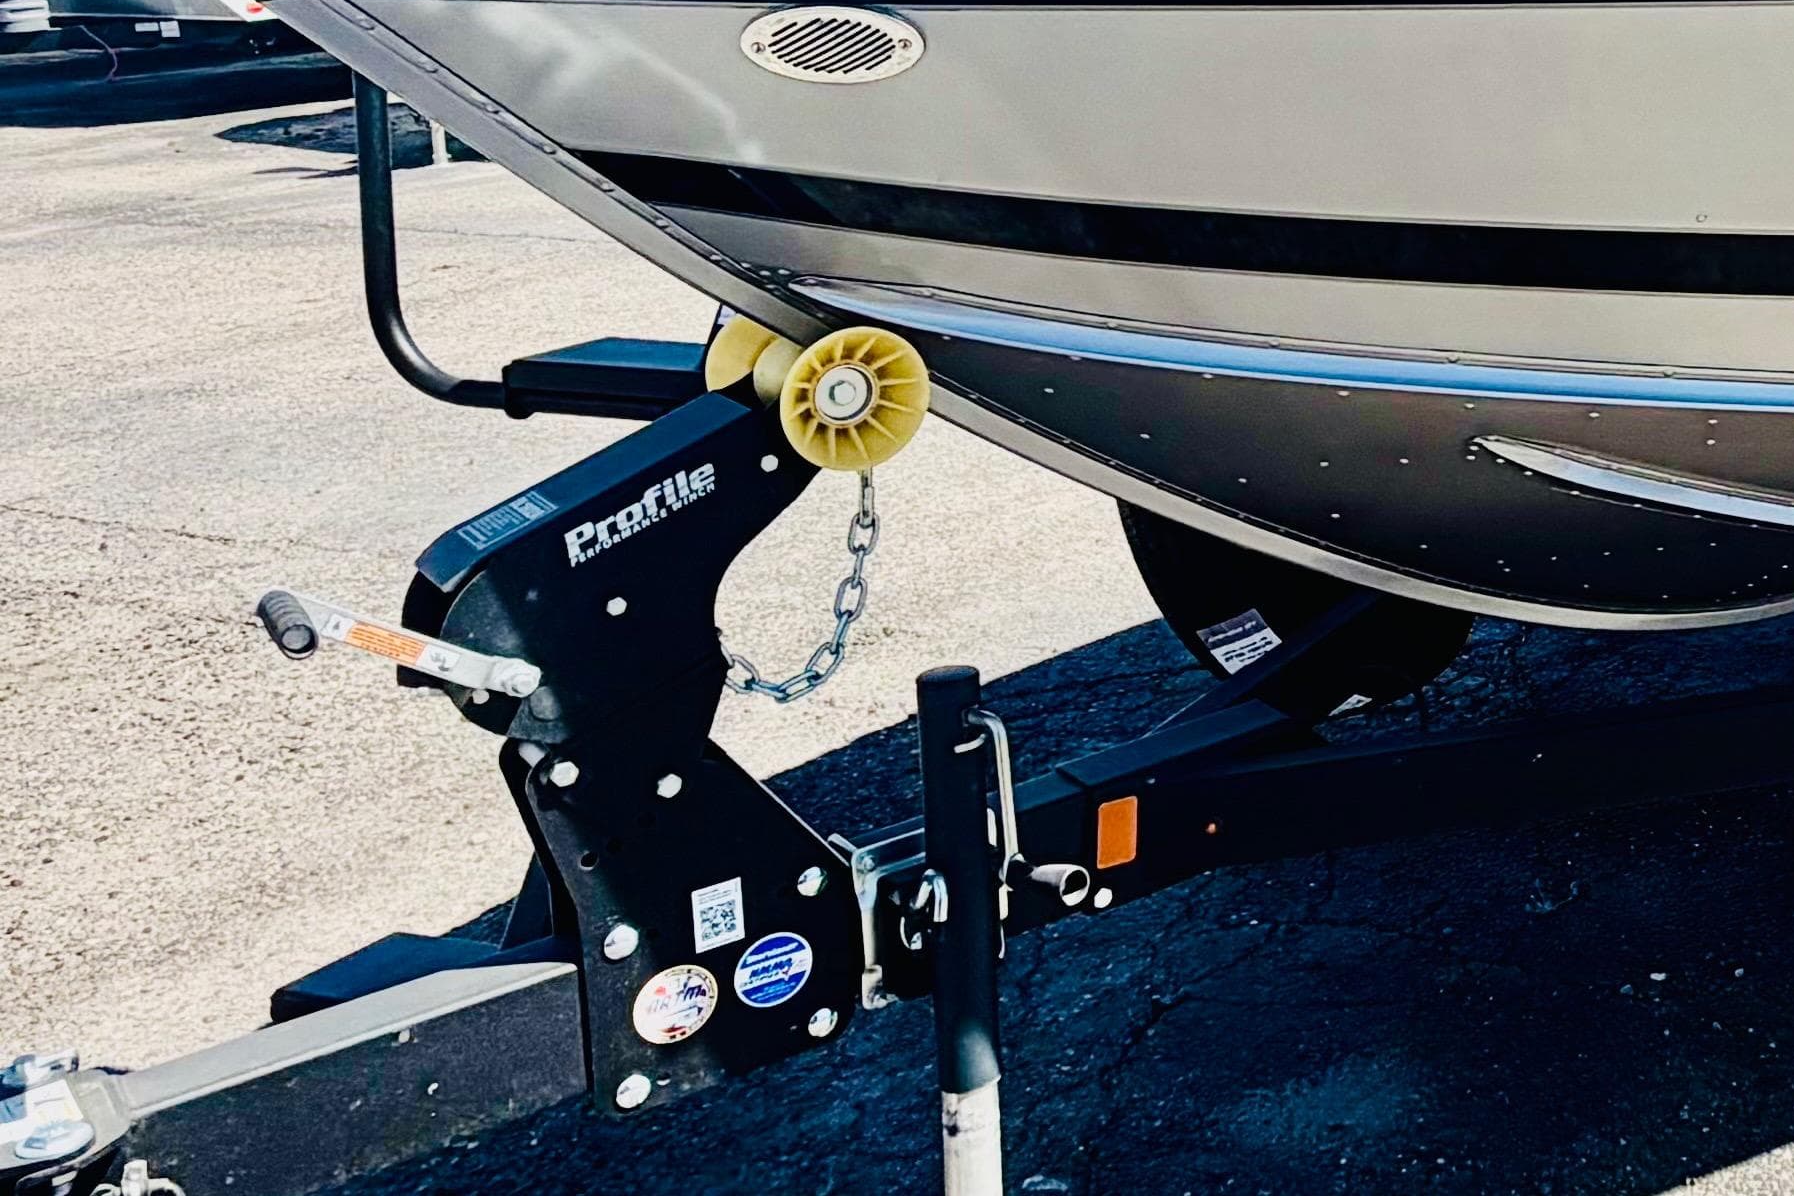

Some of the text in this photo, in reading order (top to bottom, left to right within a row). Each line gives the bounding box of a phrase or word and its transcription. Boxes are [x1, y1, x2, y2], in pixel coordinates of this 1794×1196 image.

[563, 462, 716, 560] Profile
[569, 506, 668, 568] PERFORMANCE
[670, 482, 716, 512] WINCH
